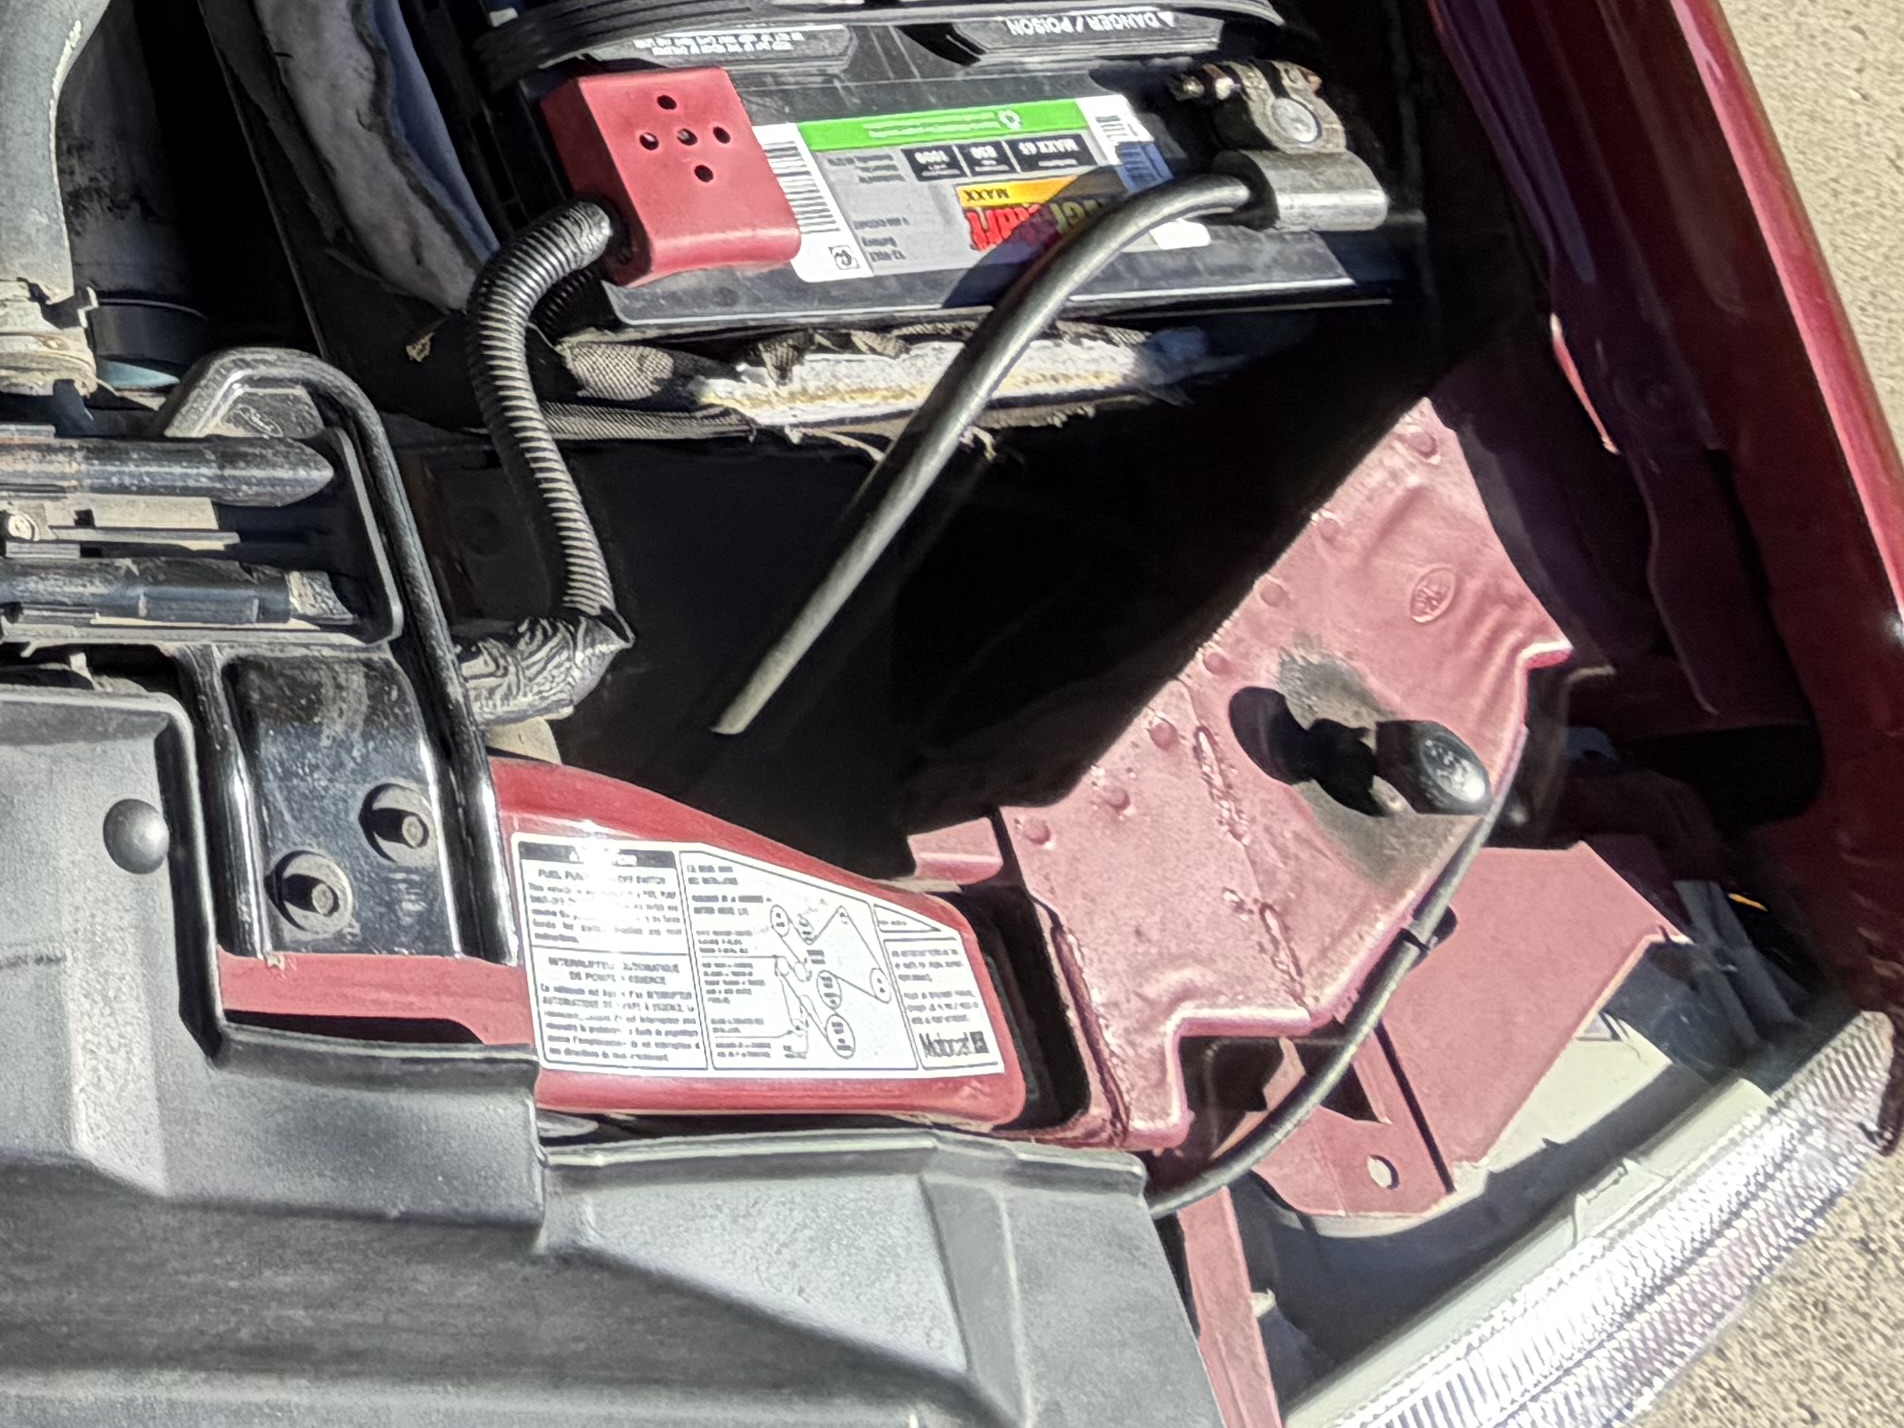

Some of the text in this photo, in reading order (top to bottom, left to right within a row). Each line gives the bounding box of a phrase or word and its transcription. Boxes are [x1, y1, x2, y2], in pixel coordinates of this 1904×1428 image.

[1005, 15, 1074, 37] POISON
[1085, 11, 1160, 33] DANGER
[1037, 138, 1080, 154] MAXX
[962, 187, 1011, 202] MAXX
